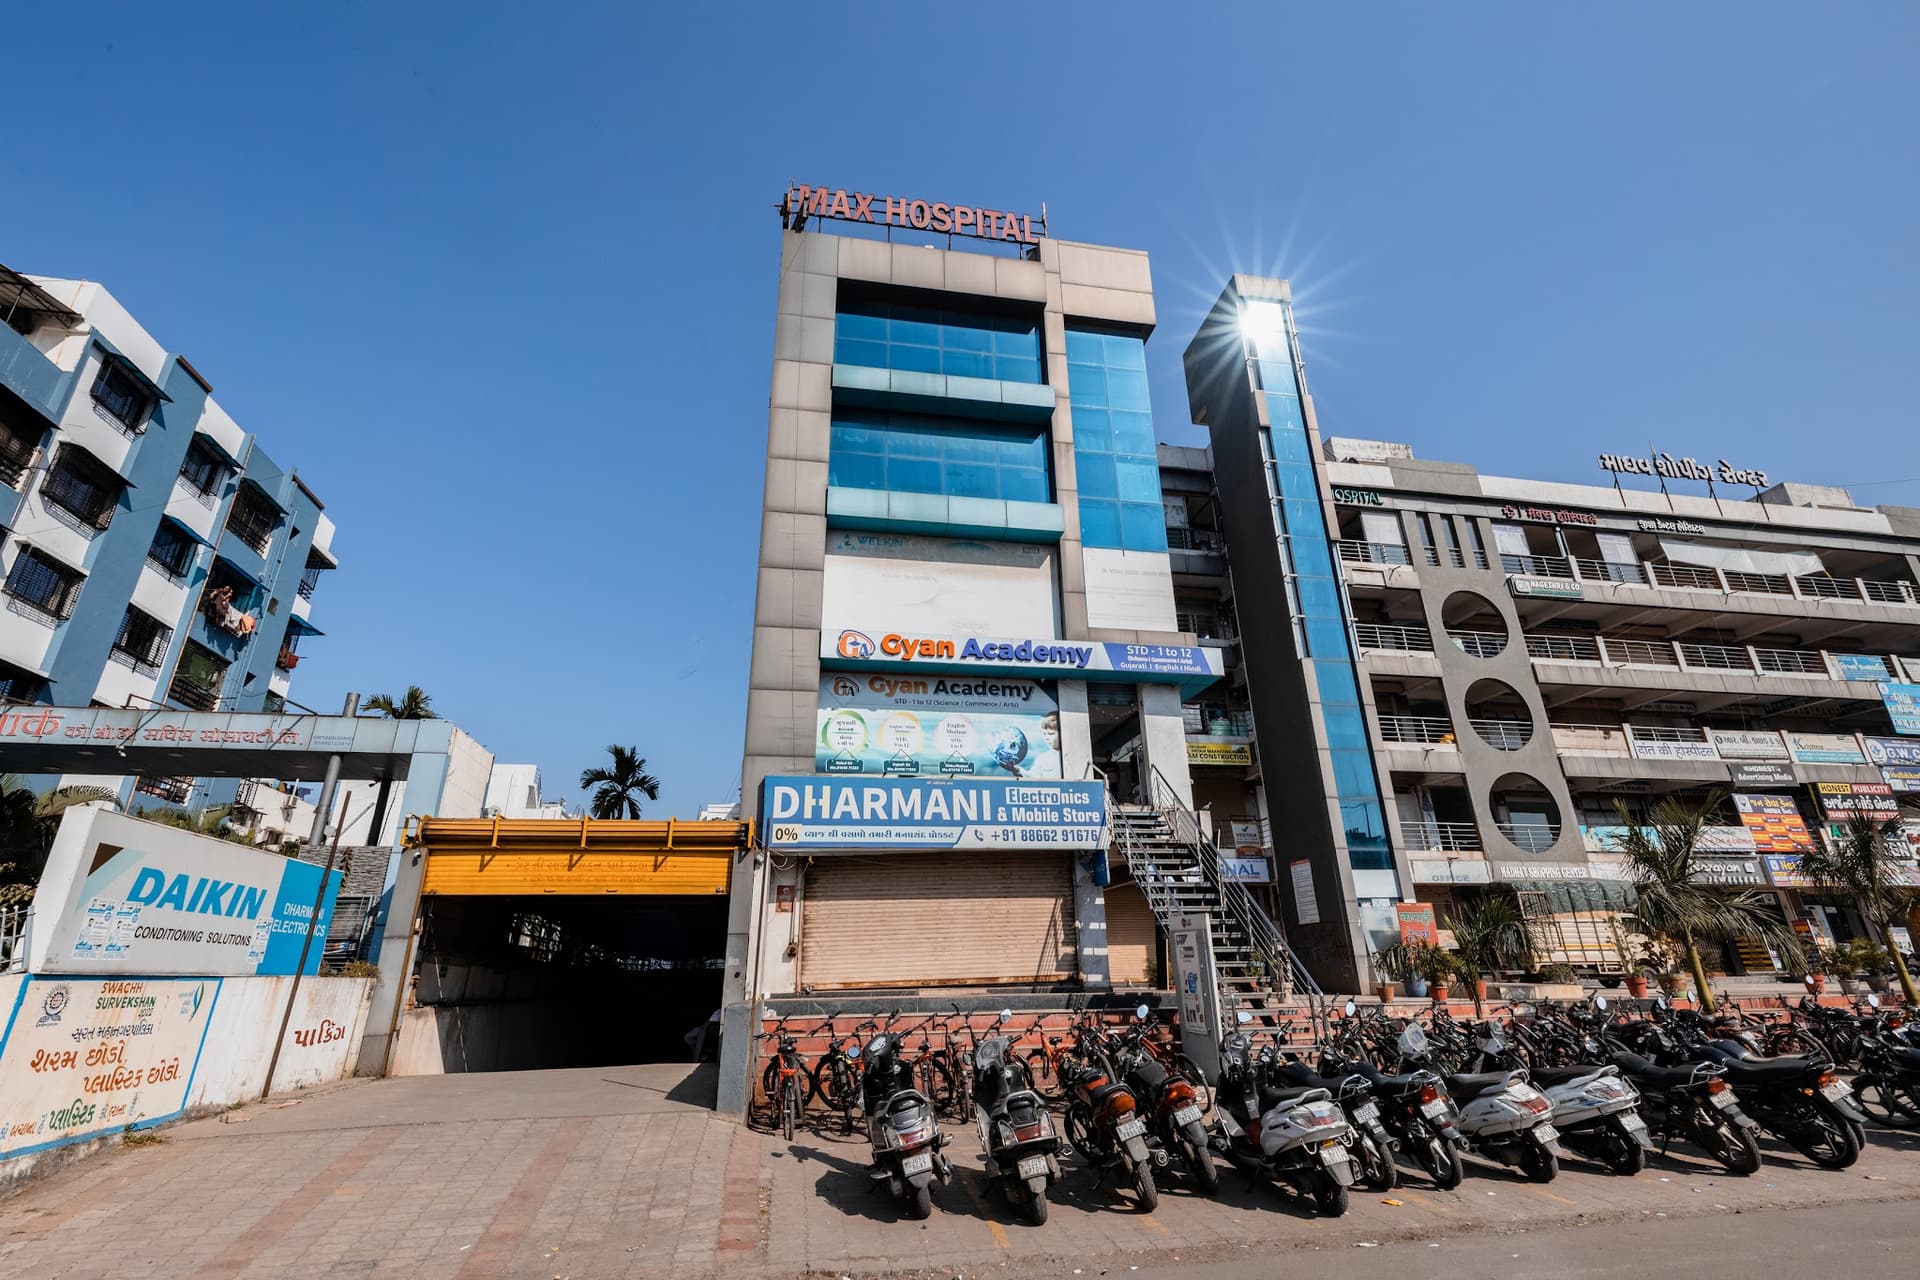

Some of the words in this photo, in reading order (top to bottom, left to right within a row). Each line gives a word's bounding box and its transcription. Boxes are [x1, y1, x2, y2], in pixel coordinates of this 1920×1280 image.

[799, 184, 875, 223] MAX
[886, 195, 1040, 244] HOSPITAL
[881, 633, 954, 661] Gyan
[960, 638, 1093, 668] Academy
[1127, 645, 1148, 655] STD
[1158, 647, 1163, 656] 1
[1166, 647, 1178, 657] to
[1181, 648, 1192, 658] 12
[1120, 662, 1147, 670] Gujarati
[1155, 664, 1179, 672] English
[868, 675, 928, 698] Gyan
[933, 679, 1034, 701] Academy
[1199, 753, 1249, 761] CONSTRUCTION
[1821, 783, 1850, 793] HONEST
[1853, 784, 1889, 793] PUBLICITY
[773, 784, 991, 822] DHARMANI
[1008, 788, 1090, 804] Electronics
[997, 807, 1008, 822] &
[1011, 807, 1059, 823] Mobile
[1063, 807, 1100, 823] Store
[775, 827, 798, 841] 0%
[991, 829, 1016, 841] +91
[1021, 829, 1058, 842] 88662
[1062, 829, 1098, 842] 91676
[1529, 866, 1561, 879] SHOPPING
[1562, 866, 1588, 879] CENTER
[1708, 875, 1761, 883] JEWELLERS
[127, 867, 267, 920] DAIKIN
[134, 926, 204, 943] CONDITIONING
[206, 932, 252, 947] SOLUTIONS
[100, 982, 142, 994] SWACHH
[95, 996, 156, 1010] SURVEKSHAN
[30, 1049, 79, 1073] શરમ
